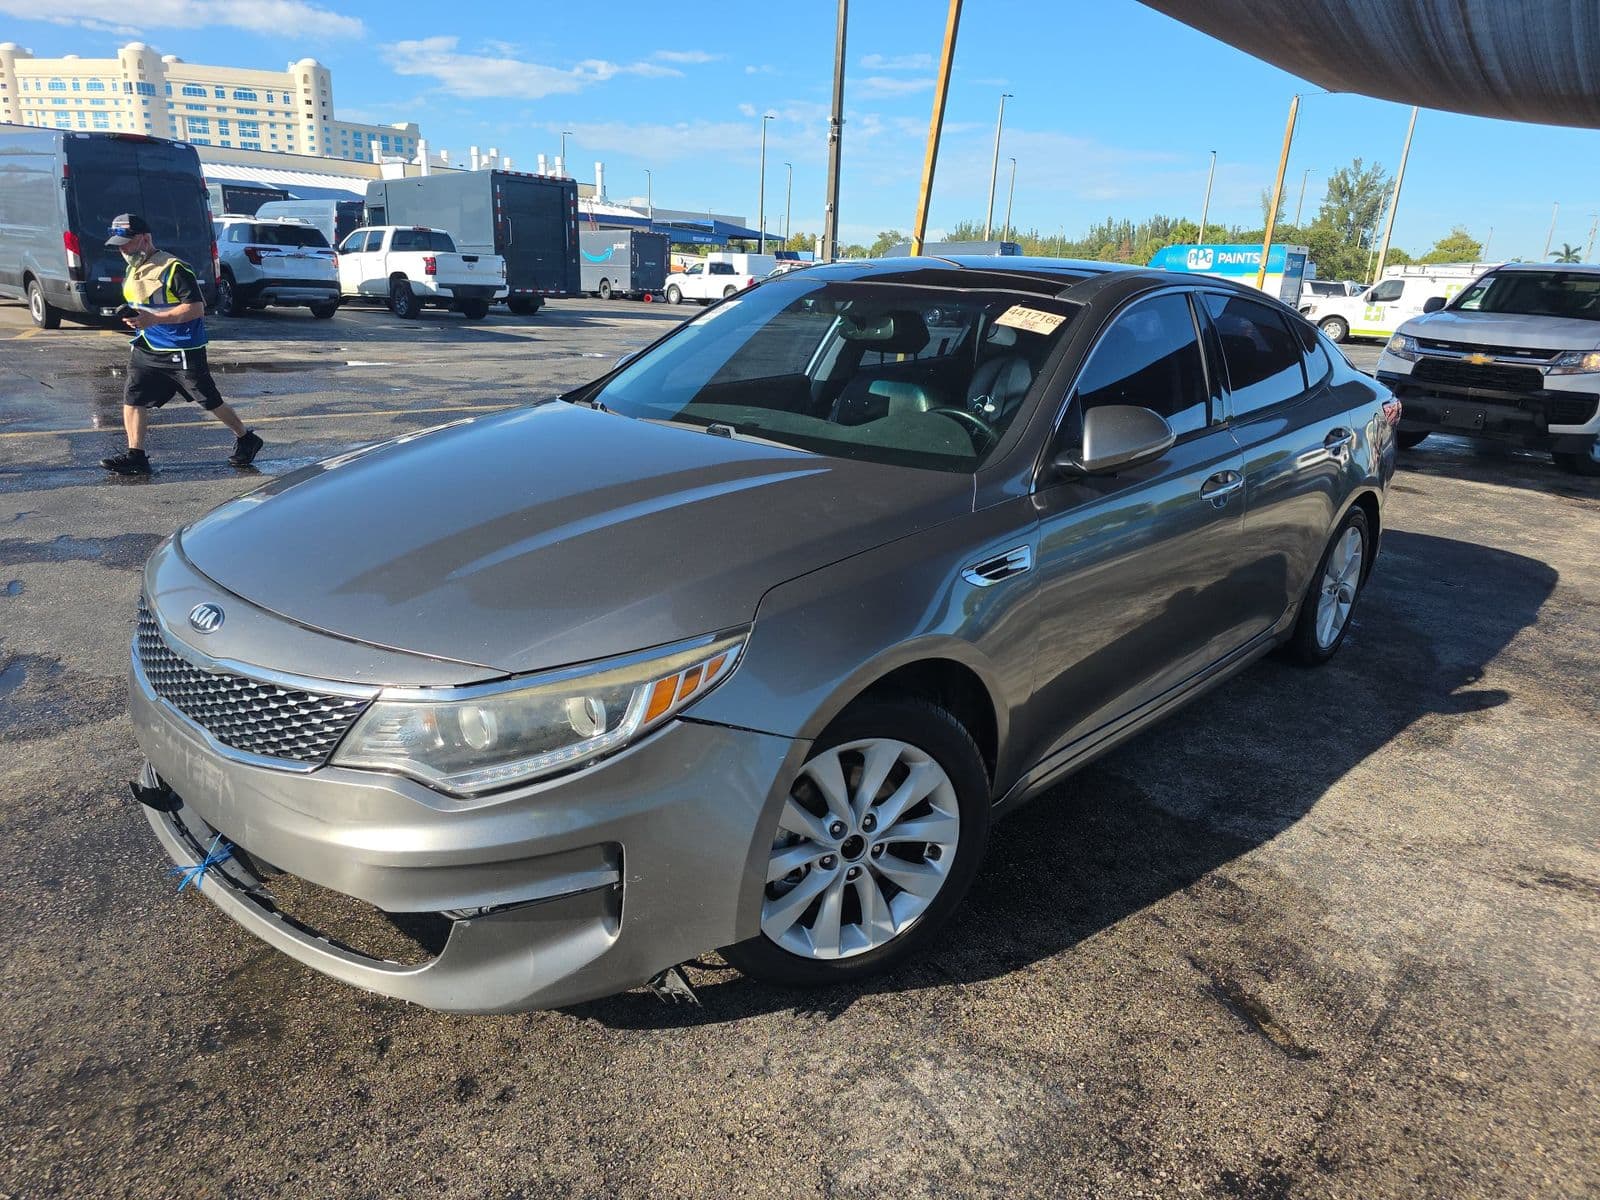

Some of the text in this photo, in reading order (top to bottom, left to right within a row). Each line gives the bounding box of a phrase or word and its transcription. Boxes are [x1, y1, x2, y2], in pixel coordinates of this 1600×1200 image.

[1188, 249, 1214, 265] PPG
[1217, 252, 1260, 264] PAINTS
[190, 606, 218, 629] KIA
